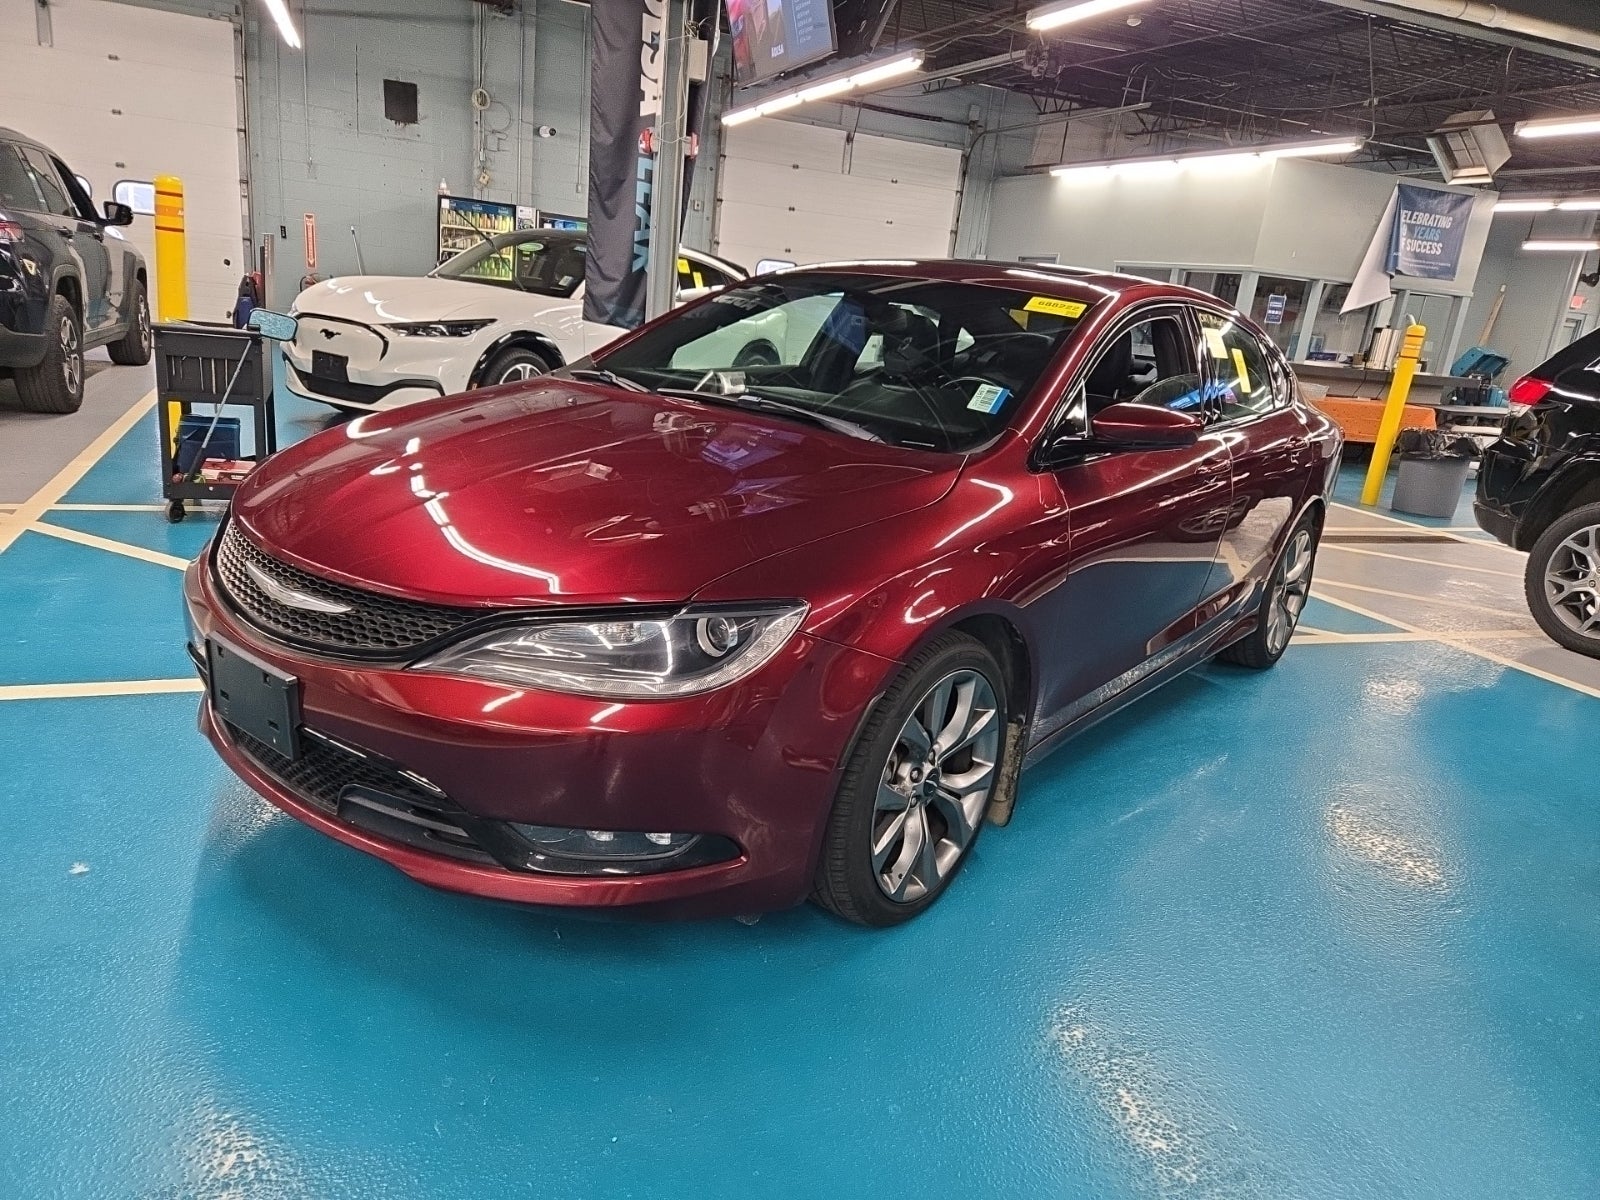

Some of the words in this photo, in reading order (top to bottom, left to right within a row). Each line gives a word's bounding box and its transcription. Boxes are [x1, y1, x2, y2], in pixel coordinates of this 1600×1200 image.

[1401, 209, 1453, 229] ELEBRATING
[1413, 226, 1441, 241] YEARS
[1406, 239, 1443, 255] SUCCESS
